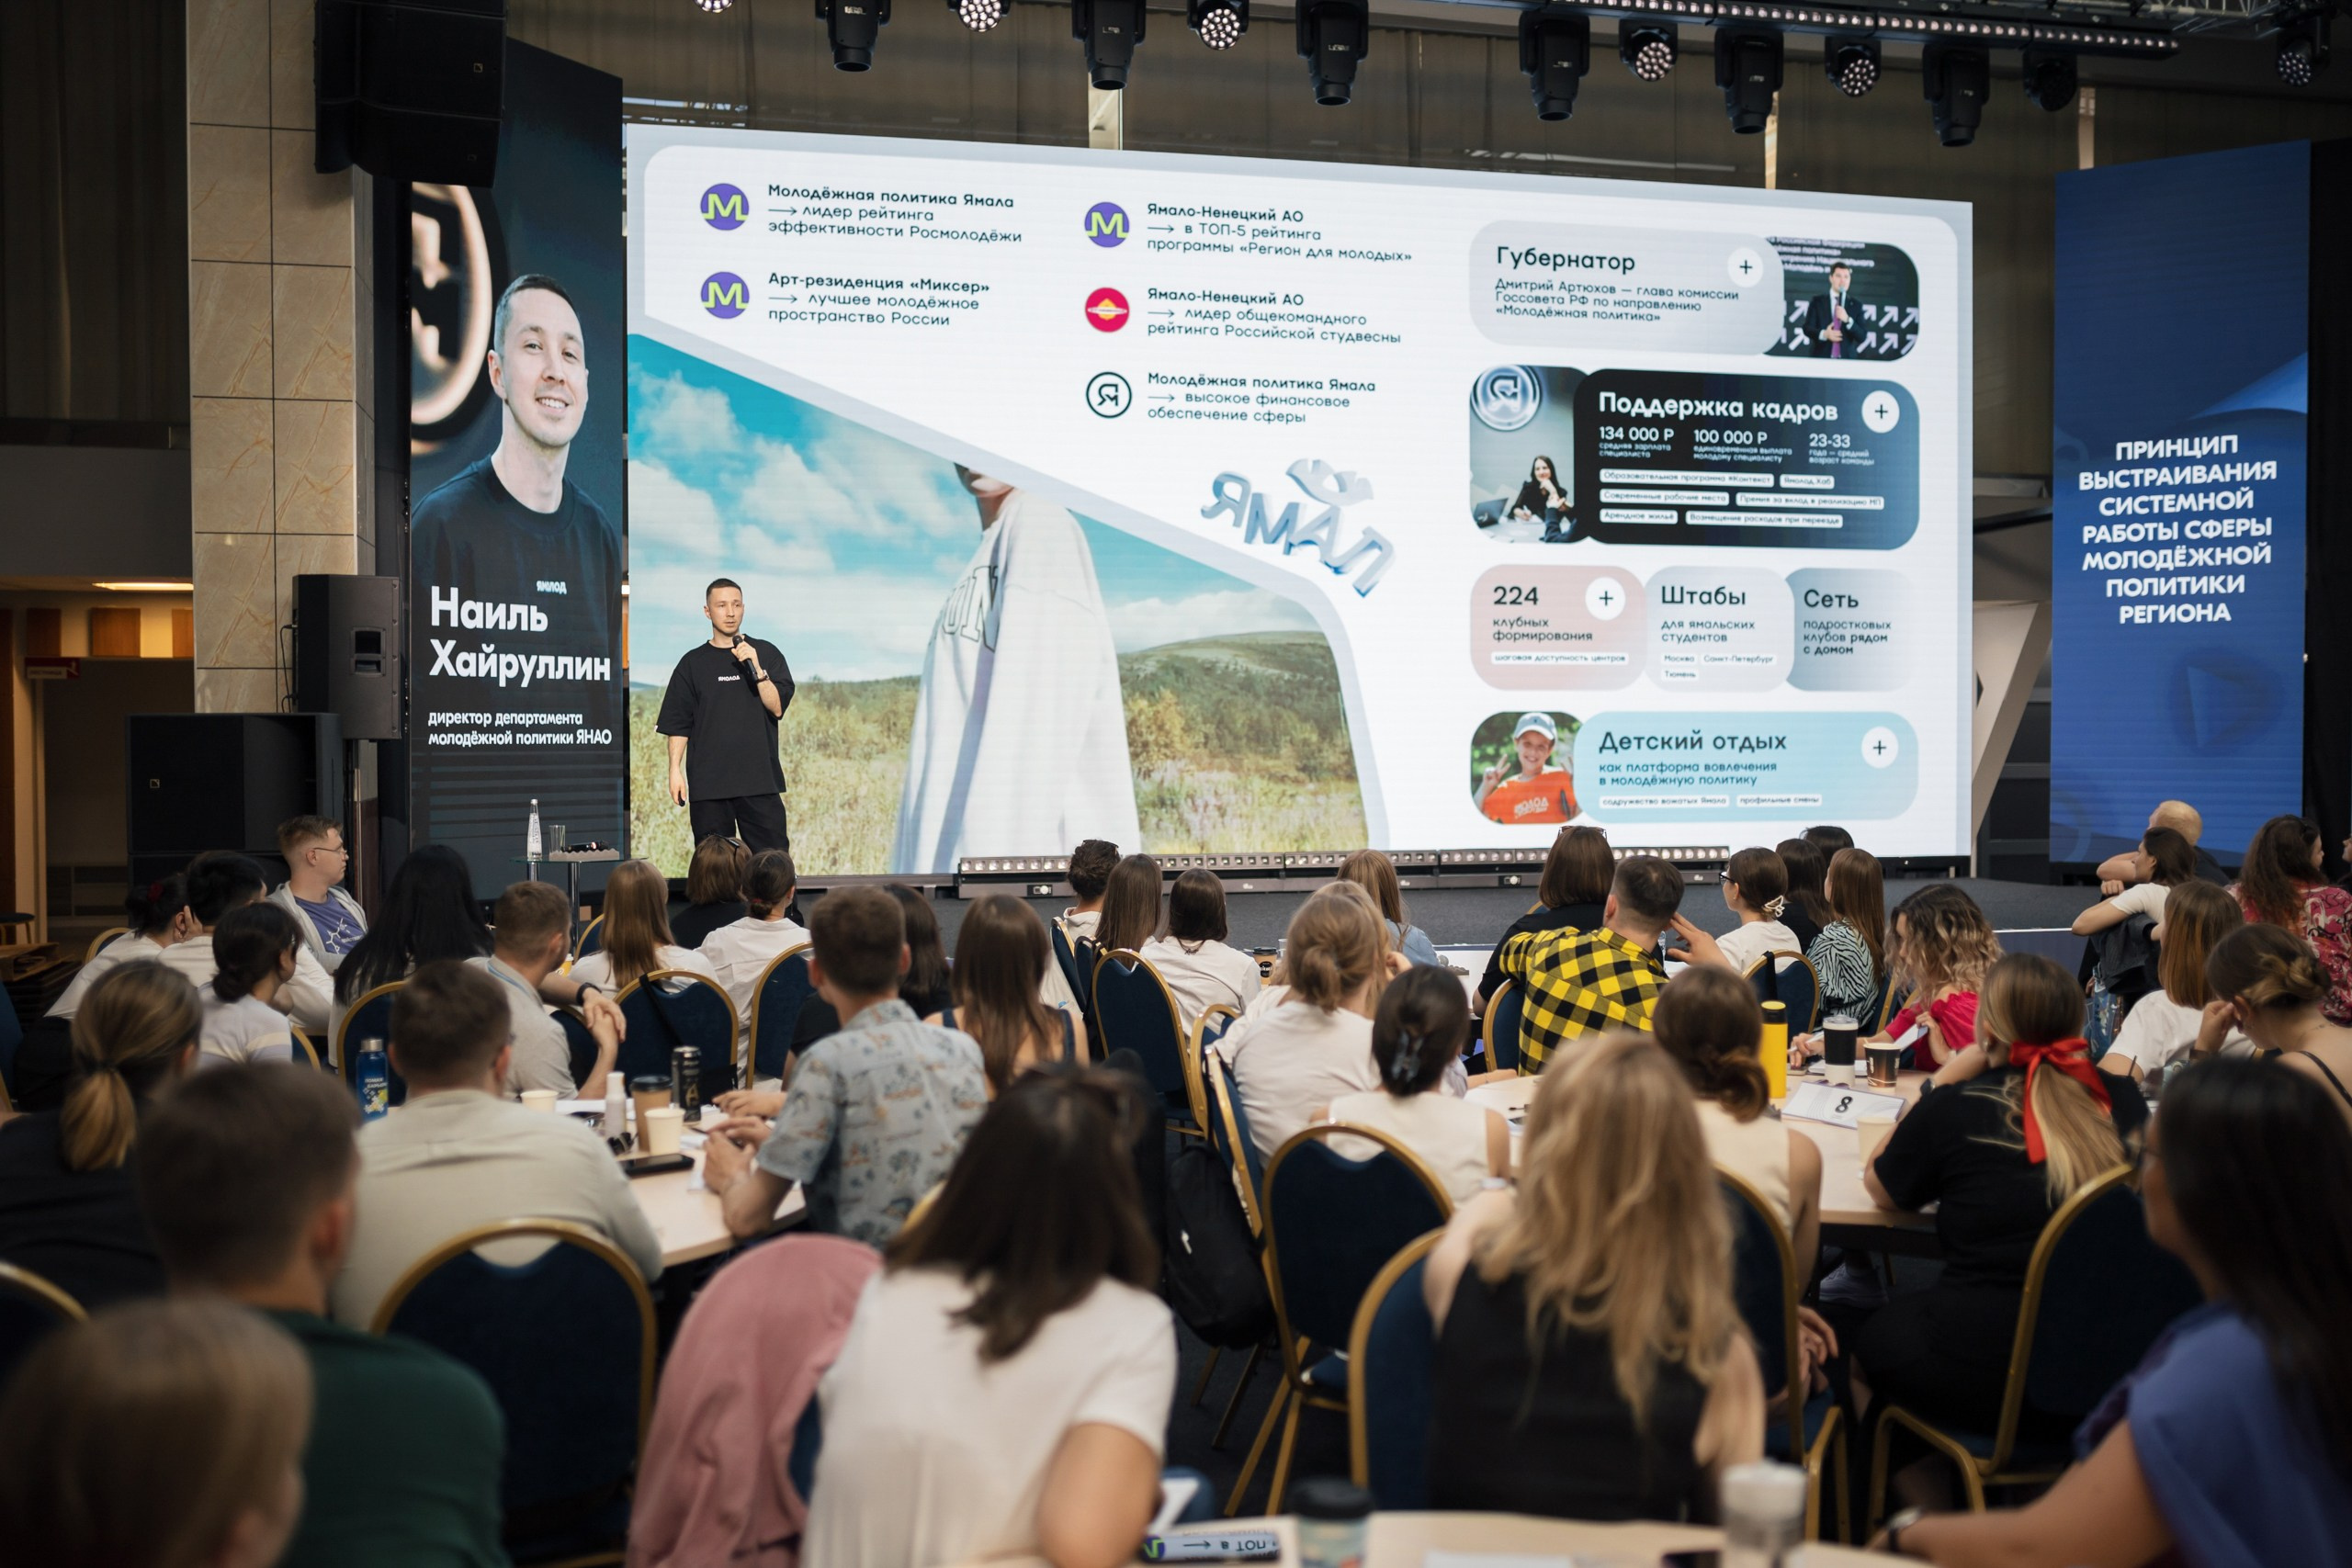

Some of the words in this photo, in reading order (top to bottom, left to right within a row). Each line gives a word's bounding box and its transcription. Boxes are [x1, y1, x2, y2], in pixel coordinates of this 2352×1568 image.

[768, 184, 875, 202] Молодёжная
[880, 191, 957, 206] политика
[964, 194, 1014, 208] Ямала
[802, 206, 853, 220] лидер
[858, 207, 934, 222] рейтинга
[1148, 203, 1276, 222] Ямало-Ненецкий
[1282, 210, 1304, 222] АО
[768, 220, 904, 238] эффективности
[910, 226, 1023, 243] Росмолодёжи
[1184, 224, 1193, 234] в
[1199, 223, 1246, 238] ТОП-5
[1251, 226, 1321, 242] рейтинга
[1148, 240, 1234, 255] программы
[1239, 243, 1301, 258] «Регион
[1306, 248, 1333, 259] для
[1339, 249, 1412, 263] молодых»
[1497, 246, 1635, 275] Губернатор
[768, 273, 904, 292] Арт-резиденция
[910, 278, 989, 293] «Миксер»
[1496, 278, 1553, 292] Дмитрий
[1559, 280, 1616, 296] Артюхов
[1637, 287, 1673, 299] глава
[1678, 288, 1739, 301] комиссии
[808, 294, 871, 308] лучшее
[877, 295, 979, 310] молодёжное
[1148, 288, 1276, 307] Ямало-Ненецкий
[1282, 294, 1304, 306] АО
[1496, 291, 1565, 305] Госсовета
[1569, 294, 1589, 307] РФ
[1594, 298, 1610, 308] по
[1613, 299, 1702, 312] направлению
[768, 310, 885, 326] пространство
[891, 311, 950, 326] России
[1185, 310, 1231, 322] лидер
[1237, 310, 1367, 325] общекомандного
[1496, 304, 1588, 320] «Молодёжная
[1593, 309, 1661, 322] политика»
[1148, 322, 1219, 338] рейтинга
[1225, 324, 1316, 341] Российской
[1320, 331, 1401, 344] студвесны
[1148, 372, 1247, 389] Молодёжная
[1252, 378, 1323, 391] политика
[1329, 379, 1376, 392] Ямала
[1185, 392, 1250, 405] высокое
[1255, 392, 1351, 409] финансовое
[1599, 391, 1745, 421] Поддержка
[1751, 400, 1838, 426] кадров
[1148, 407, 1248, 423] обеспечение
[1253, 410, 1306, 425] сферы
[1600, 426, 1624, 441] 134
[1628, 428, 1659, 442] 000
[1693, 430, 1719, 444] 100
[1723, 431, 1753, 445] 000
[1809, 434, 1850, 448] 23-33
[2116, 434, 2238, 461] ПРИНЦИП
[2079, 460, 2278, 491] ВЫСТРАИВАНИЯ
[2098, 486, 2254, 516] СИСТЕМНОЙ
[2082, 521, 2178, 545] РАБОТЫ
[2184, 516, 2272, 539] СФЕРЫ
[2081, 542, 2272, 571] МОЛОДЁЖНОЙ
[1493, 586, 1539, 606] 224
[1661, 585, 1747, 606] Штабы
[2106, 575, 2245, 598] ПОЛИТИКИ
[431, 585, 548, 632] Наиль
[1804, 589, 1860, 609] Сеть
[1493, 616, 1549, 629] клубных
[2120, 603, 2233, 625] РЕГИОНА
[1660, 620, 1684, 630] для
[1689, 620, 1756, 630] ямальских
[1804, 618, 1892, 633] подростковых
[1493, 629, 1593, 643] формирования
[1661, 633, 1728, 644] студентов
[1804, 630, 1847, 644] клубов
[1849, 633, 1888, 646] рядом
[1534, 654, 1589, 662] доступность
[1591, 655, 1625, 663] центров
[1703, 655, 1773, 664] Санкт-Петербург
[1804, 646, 1811, 655] с
[1814, 645, 1854, 657] домом
[429, 638, 611, 688] Хайруллин
[428, 711, 492, 728] директор
[494, 712, 582, 728] департамента
[428, 729, 513, 748] молодёжной
[515, 730, 573, 745] политики
[575, 729, 612, 745] ЯНАО
[1599, 729, 1704, 755] Детский
[1713, 734, 1787, 755] отдых
[1600, 763, 1622, 773] как
[1626, 761, 1700, 774] платформа
[1704, 762, 1777, 773] вовлечения
[1600, 777, 1607, 785] в
[1611, 774, 1695, 788] молодёжную
[1699, 775, 1757, 787] политику
[1602, 797, 1658, 807] содружество
[1661, 797, 1698, 806] вожатых
[1739, 796, 1792, 806] профильные
[1835, 1095, 1853, 1113] 8
